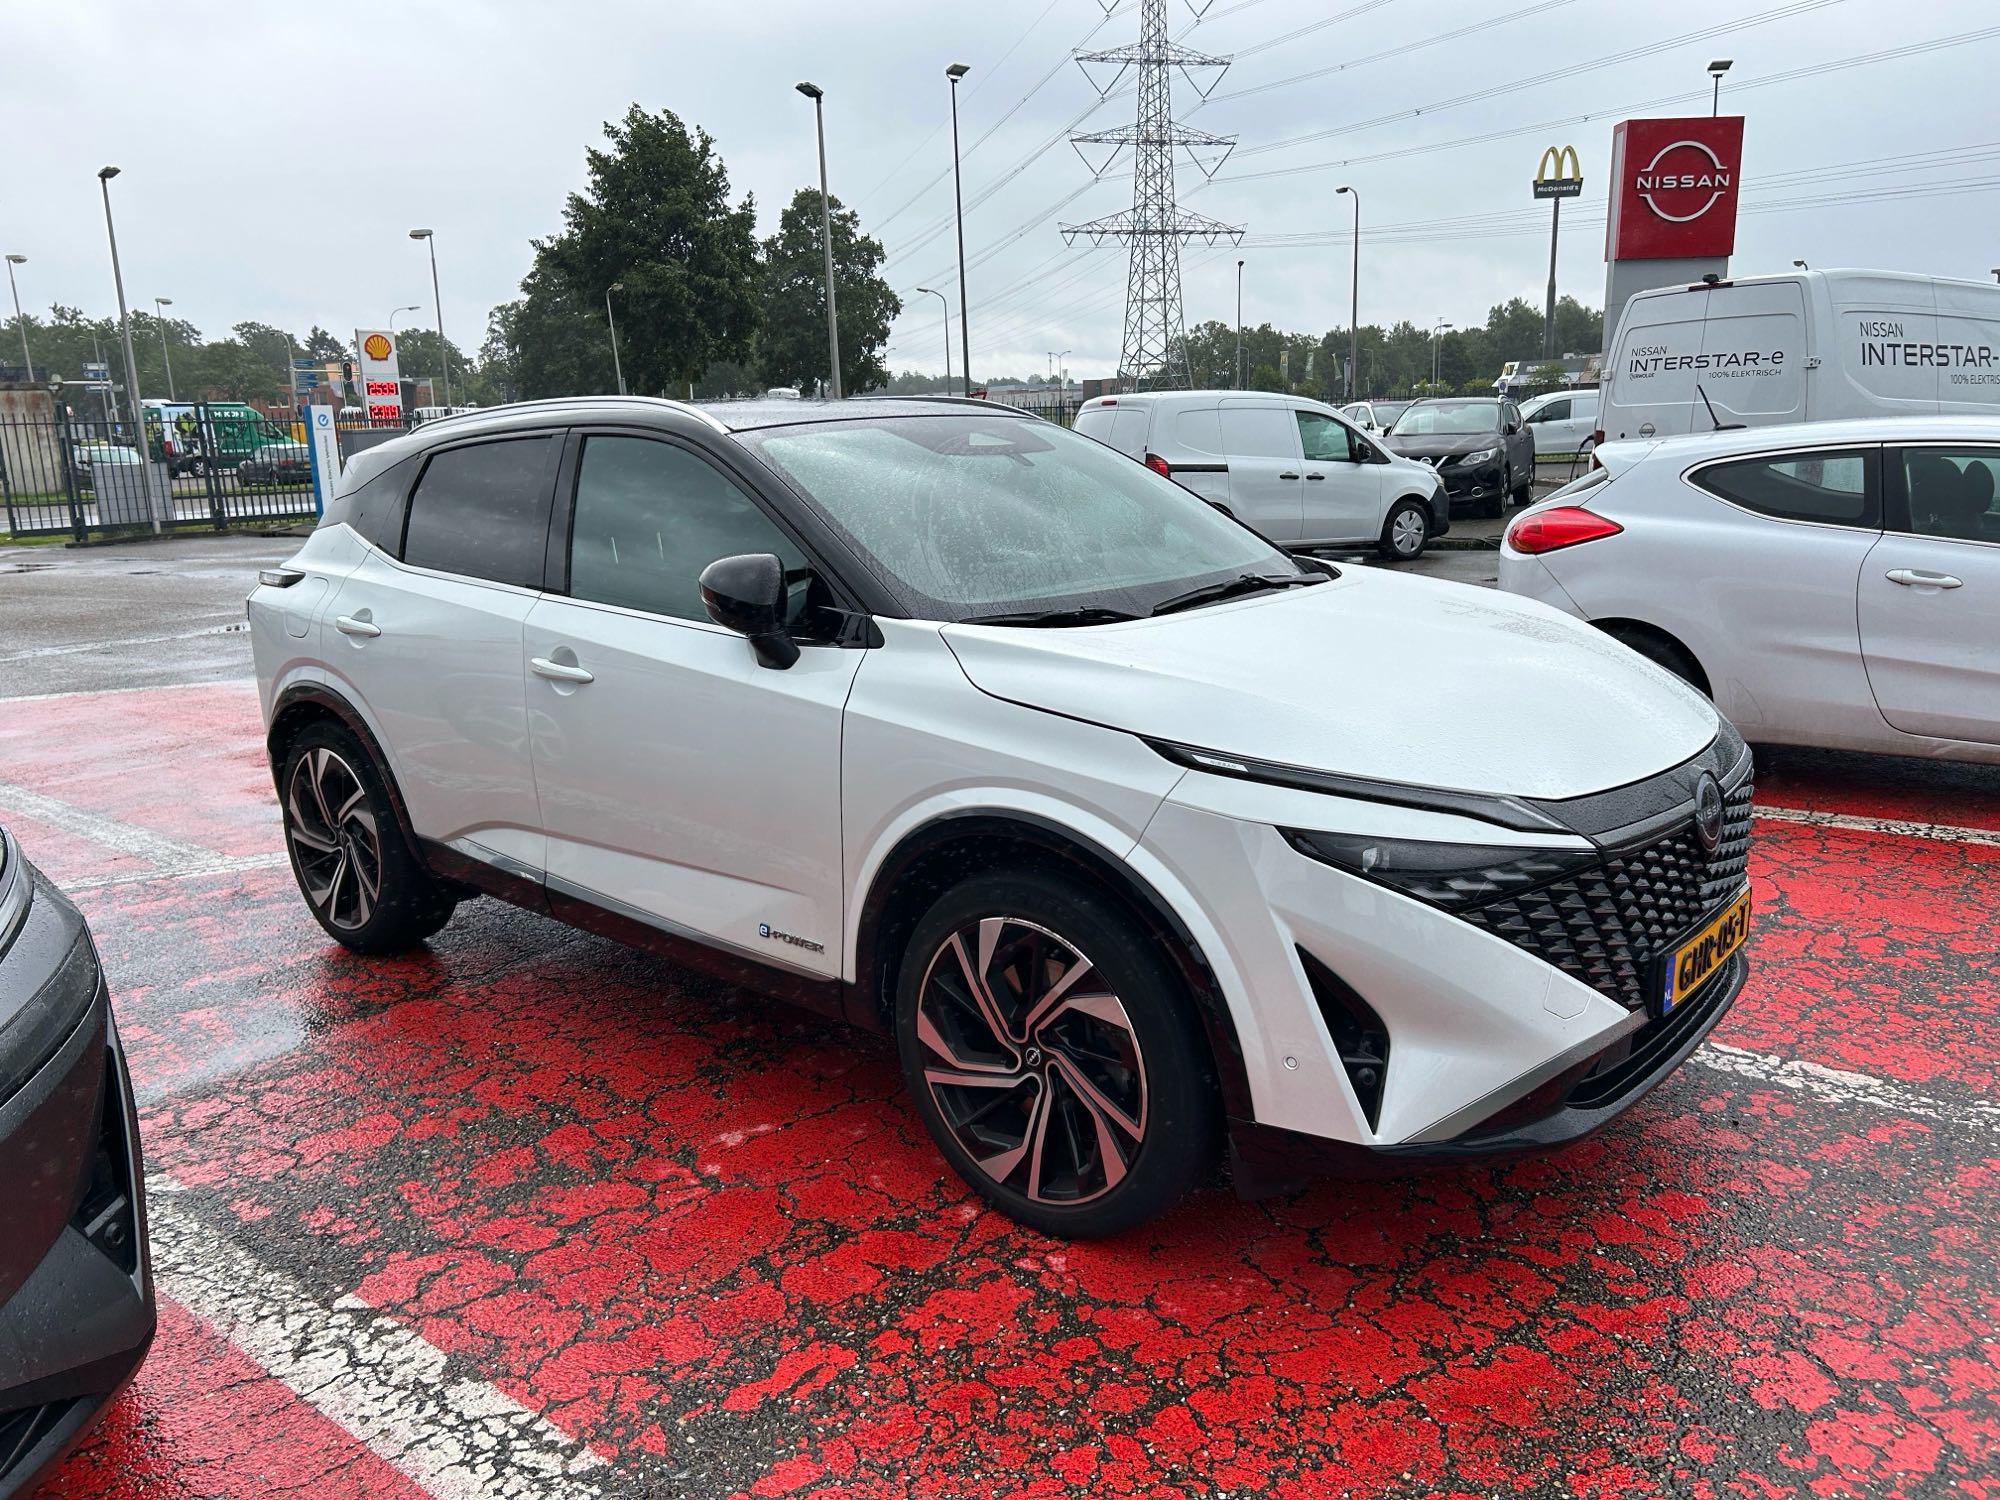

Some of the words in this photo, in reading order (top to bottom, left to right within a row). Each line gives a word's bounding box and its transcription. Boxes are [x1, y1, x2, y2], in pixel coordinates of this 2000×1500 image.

[1636, 174, 1730, 189] NISSAN
[1860, 321, 1904, 337] NISSAN
[1631, 346, 1667, 357] NISSAN
[1861, 342, 2000, 367] INTERSTAR-
[1629, 350, 1784, 373] INTERSTAR-e
[1708, 370, 1729, 379] 100%
[1731, 369, 1782, 378] ELEKTRISCH
[1950, 374, 1969, 384] 100%
